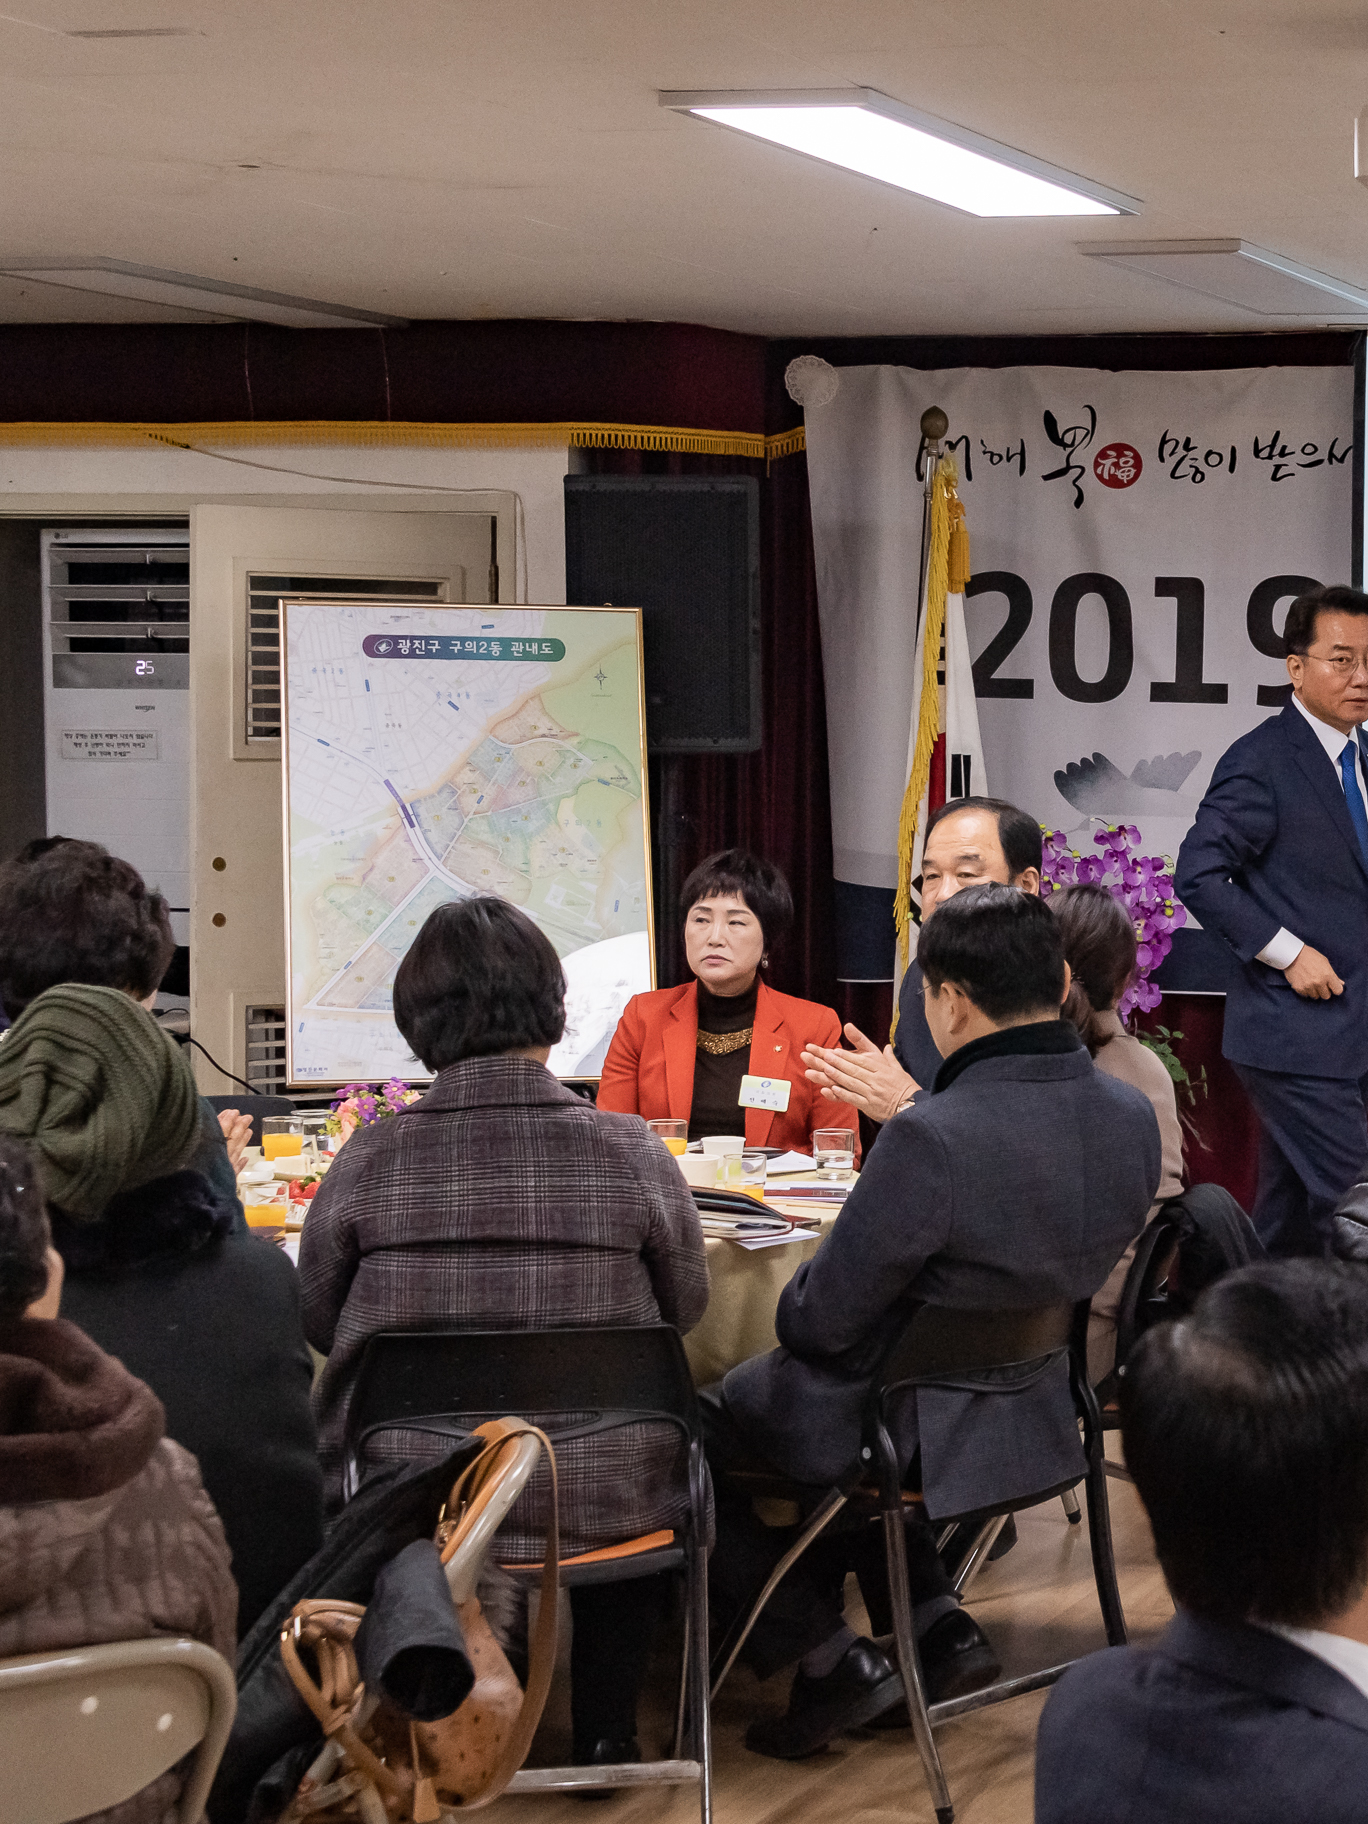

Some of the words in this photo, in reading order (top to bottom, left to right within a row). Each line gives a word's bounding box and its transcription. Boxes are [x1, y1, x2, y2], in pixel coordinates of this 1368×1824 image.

[1041, 404, 1097, 509] 복
[1096, 449, 1138, 485] 福
[1158, 429, 1237, 483] 많이
[135, 660, 155, 675] 25
[396, 639, 442, 655] 광진구
[449, 639, 503, 656] 구의2동
[510, 641, 554, 656] 관내도
[964, 570, 1328, 709] 2019
